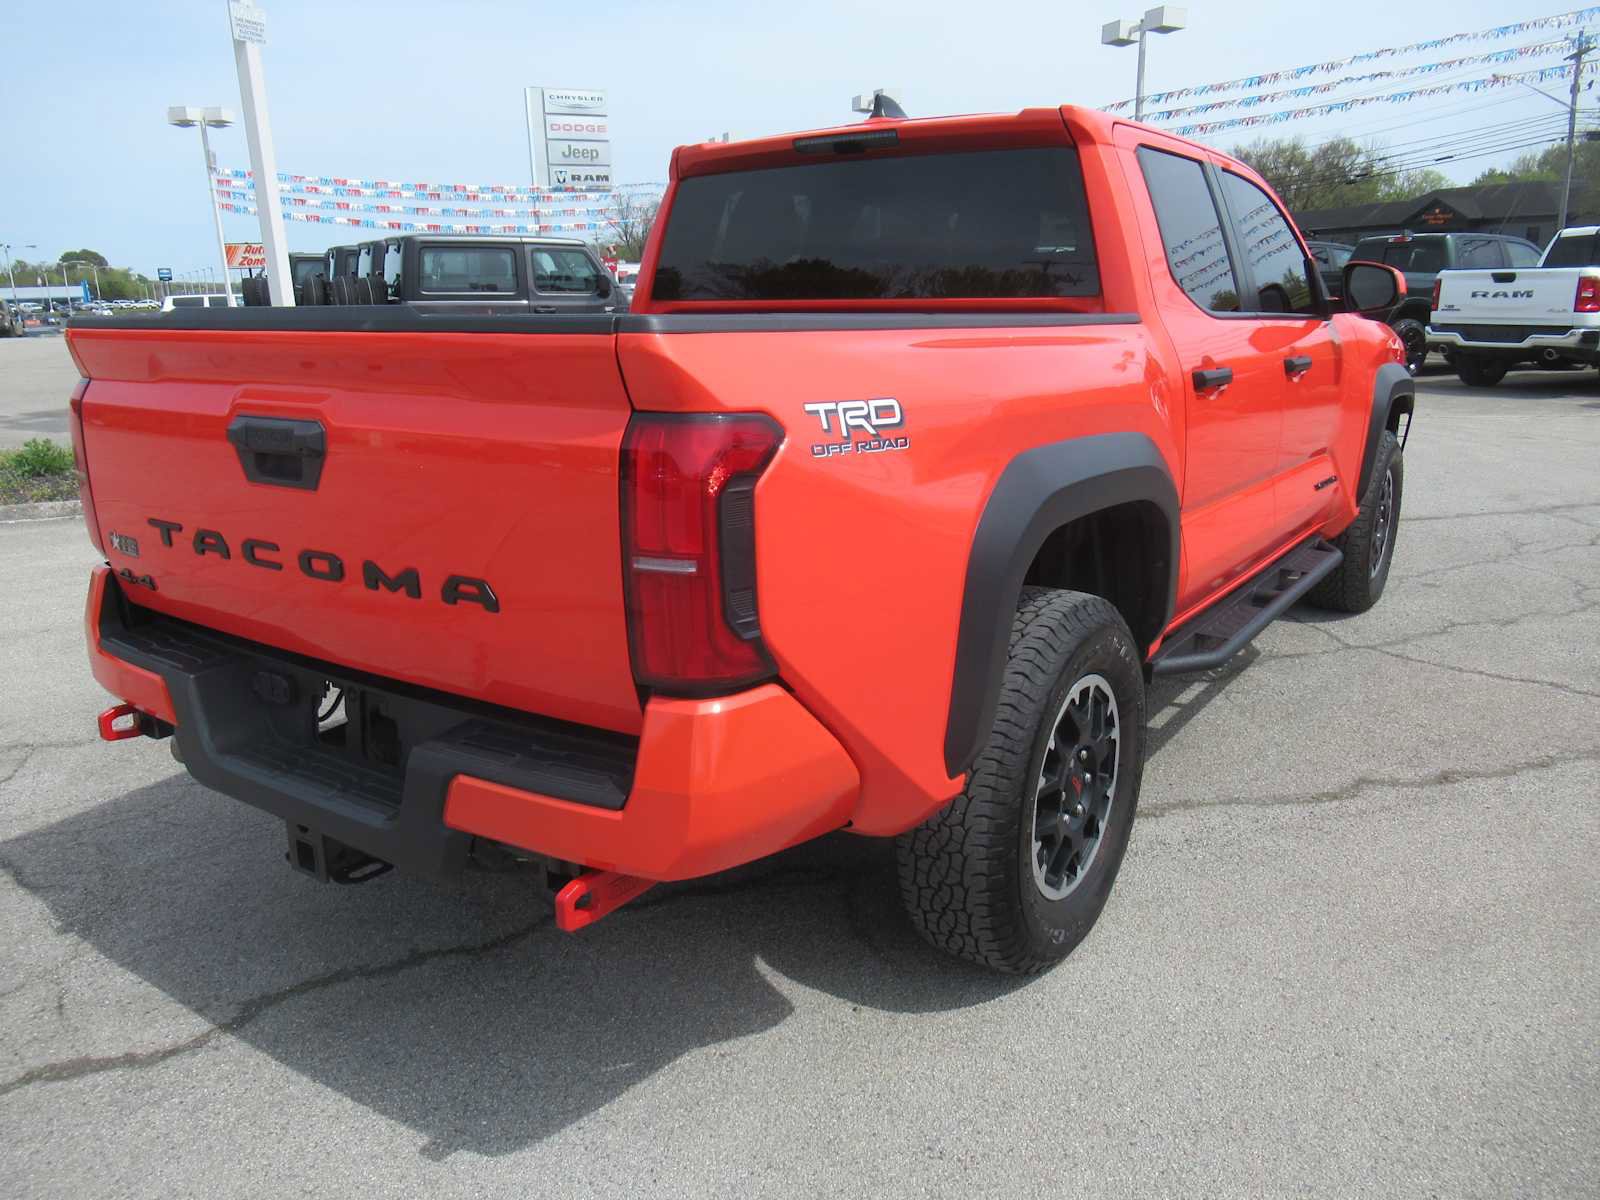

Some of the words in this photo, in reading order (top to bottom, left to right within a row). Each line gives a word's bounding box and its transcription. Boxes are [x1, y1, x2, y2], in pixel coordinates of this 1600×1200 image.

[549, 94, 603, 102] CHRYSLER
[550, 123, 608, 133] DODGE
[562, 144, 600, 162] Jeep
[571, 174, 610, 182] RAM
[1471, 290, 1534, 299] RAM
[803, 397, 904, 440] TRD
[812, 444, 853, 458] OFF
[856, 438, 910, 454] ROAD
[147, 517, 500, 613] TACOMA
